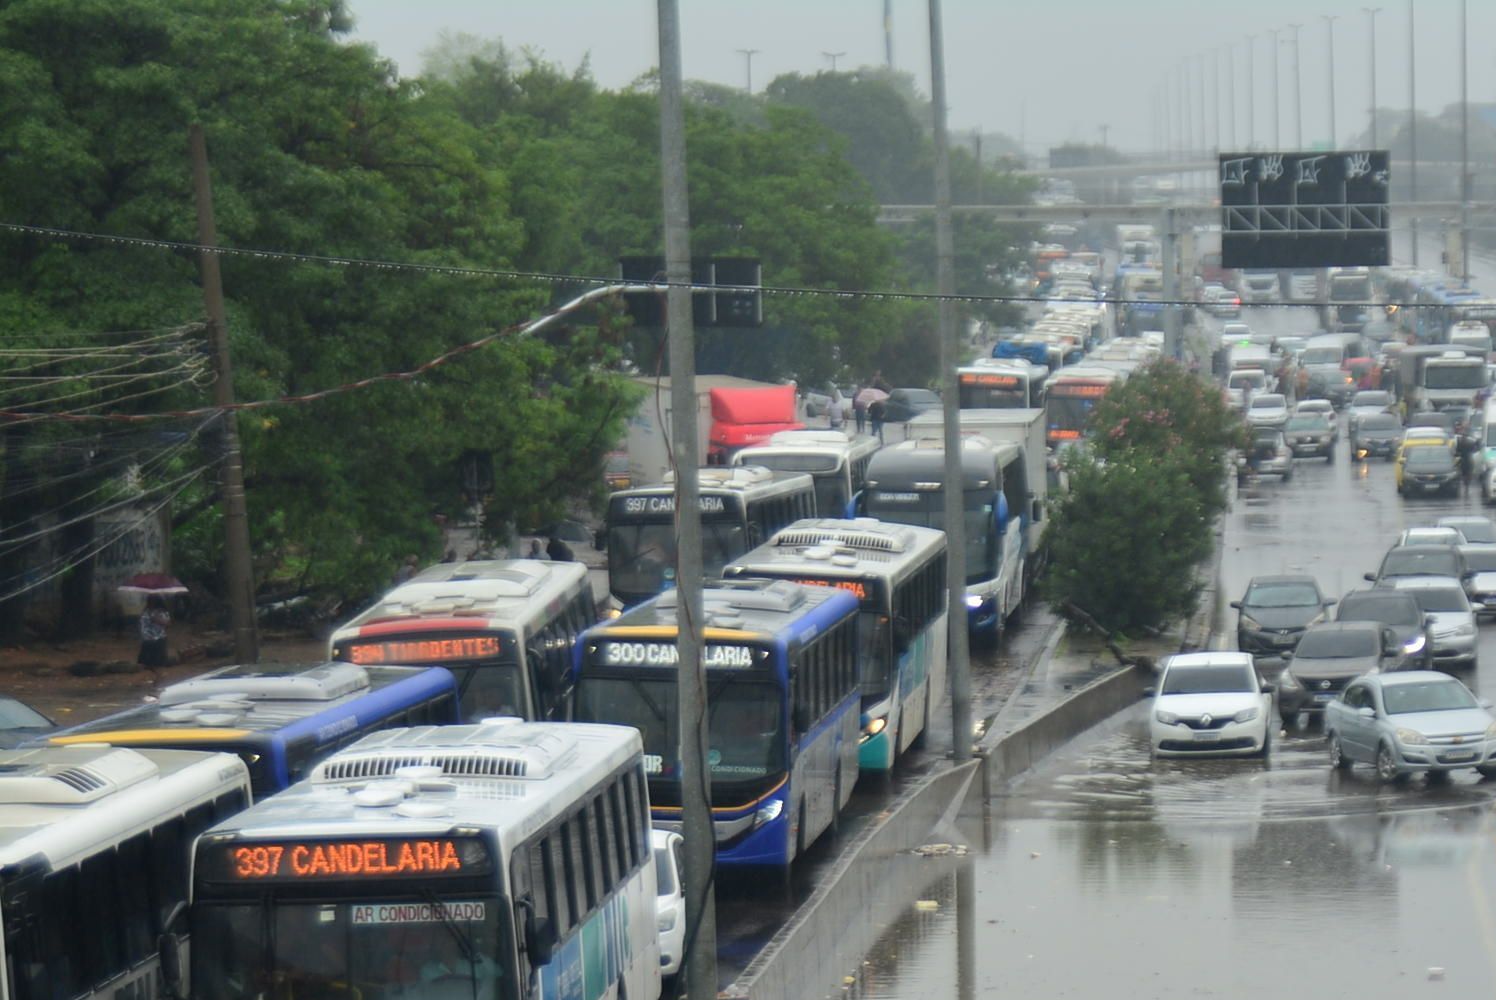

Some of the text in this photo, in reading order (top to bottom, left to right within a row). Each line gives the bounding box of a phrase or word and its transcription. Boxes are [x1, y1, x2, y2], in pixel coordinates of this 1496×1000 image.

[609, 642, 752, 666] 300 CANLARIA
[235, 840, 460, 876] 397 CANDELARIA
[355, 903, 484, 922] AR CONDICIONADO
